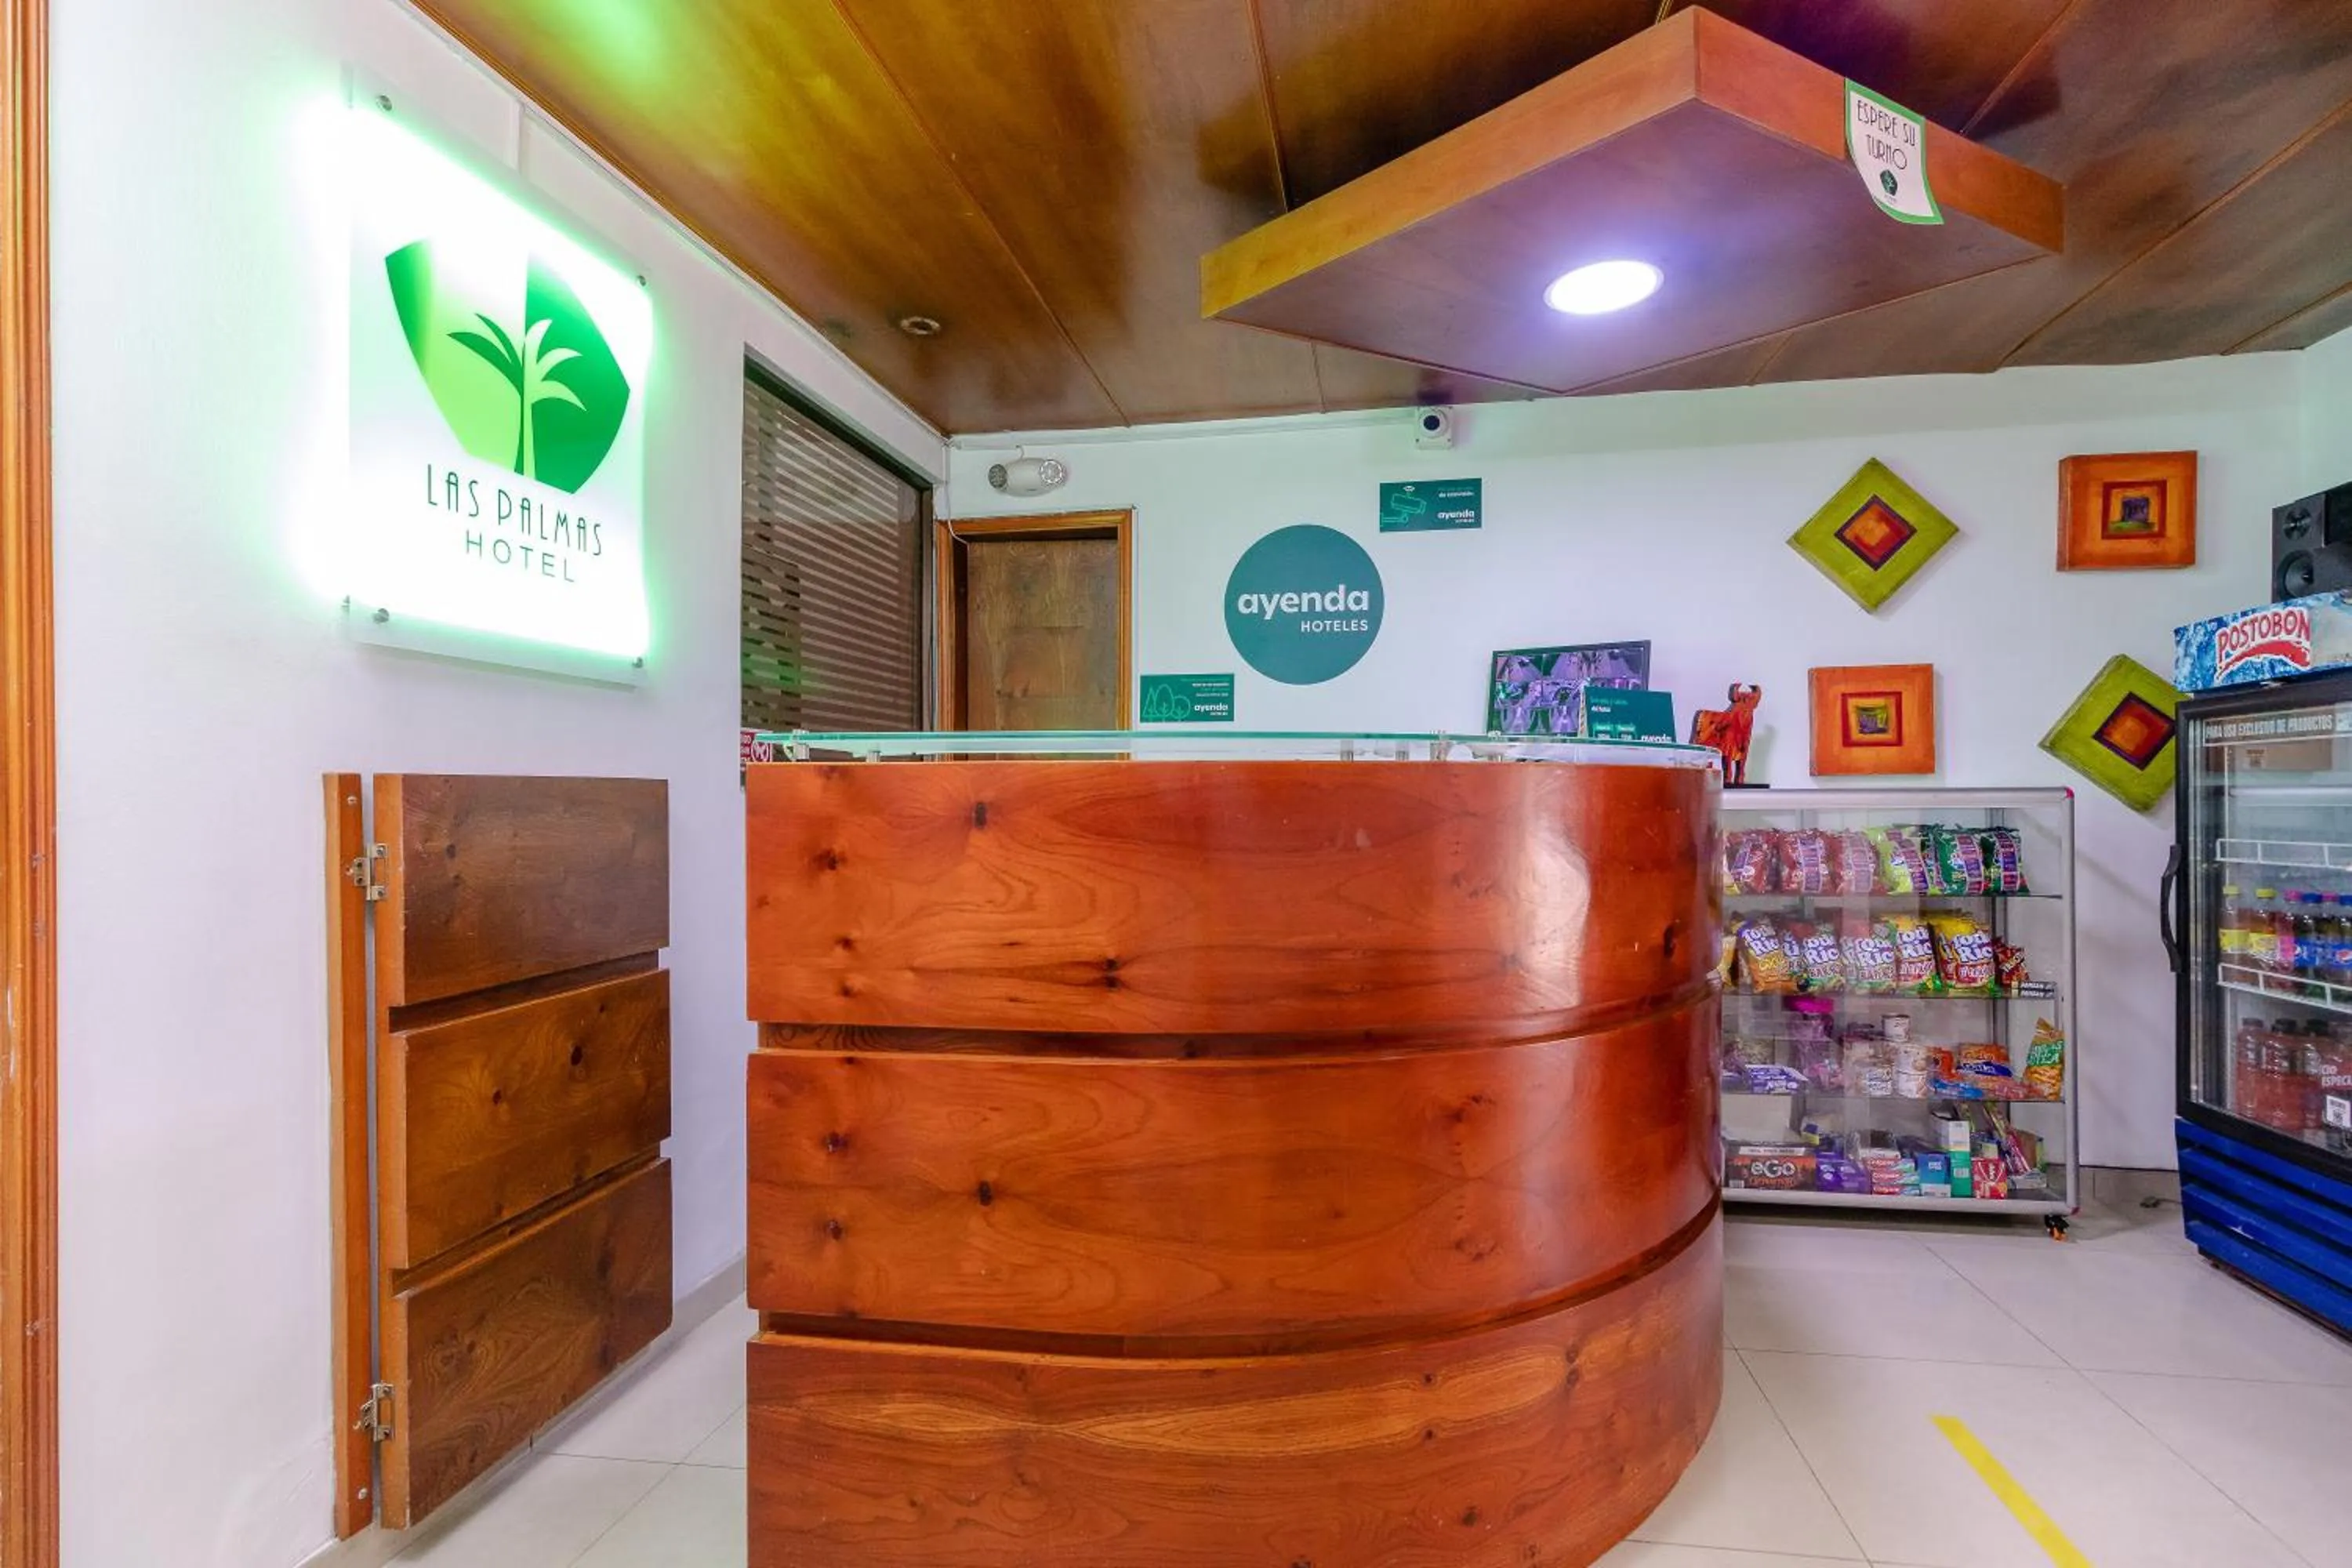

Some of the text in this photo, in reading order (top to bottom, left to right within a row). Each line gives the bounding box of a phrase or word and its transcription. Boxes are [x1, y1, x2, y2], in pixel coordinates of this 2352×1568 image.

[1857, 100, 1915, 147] ESPERE SU
[1865, 134, 1907, 169] TURNO
[427, 463, 601, 556] LAS PALMAS
[466, 529, 575, 583] HOTEL
[1237, 583, 1369, 620] ayenda
[1300, 619, 1369, 633] HOTELES
[1194, 702, 1229, 713] ayenda
